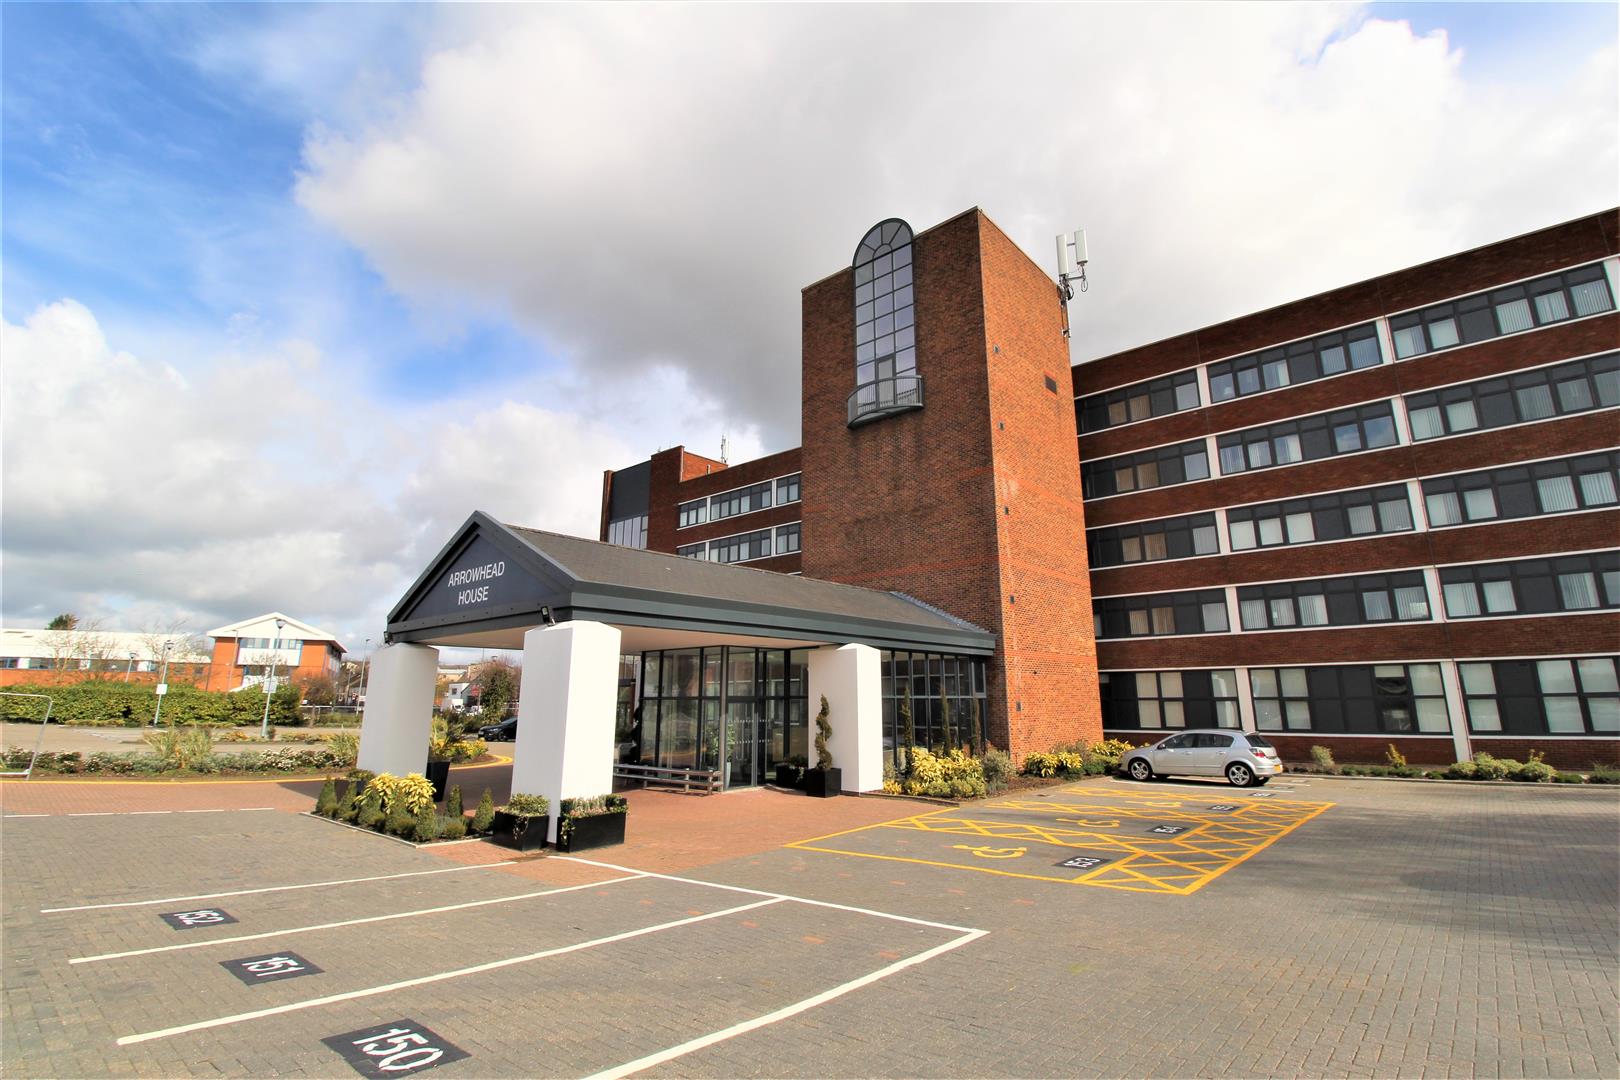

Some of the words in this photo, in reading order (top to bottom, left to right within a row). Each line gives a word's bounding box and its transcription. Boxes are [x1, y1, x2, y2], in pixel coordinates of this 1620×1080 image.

[448, 561, 505, 587] ARROWHEAD
[457, 586, 489, 605] HOUSE
[173, 910, 224, 925] 152
[242, 956, 304, 977] 151
[352, 1028, 444, 1071] 150
